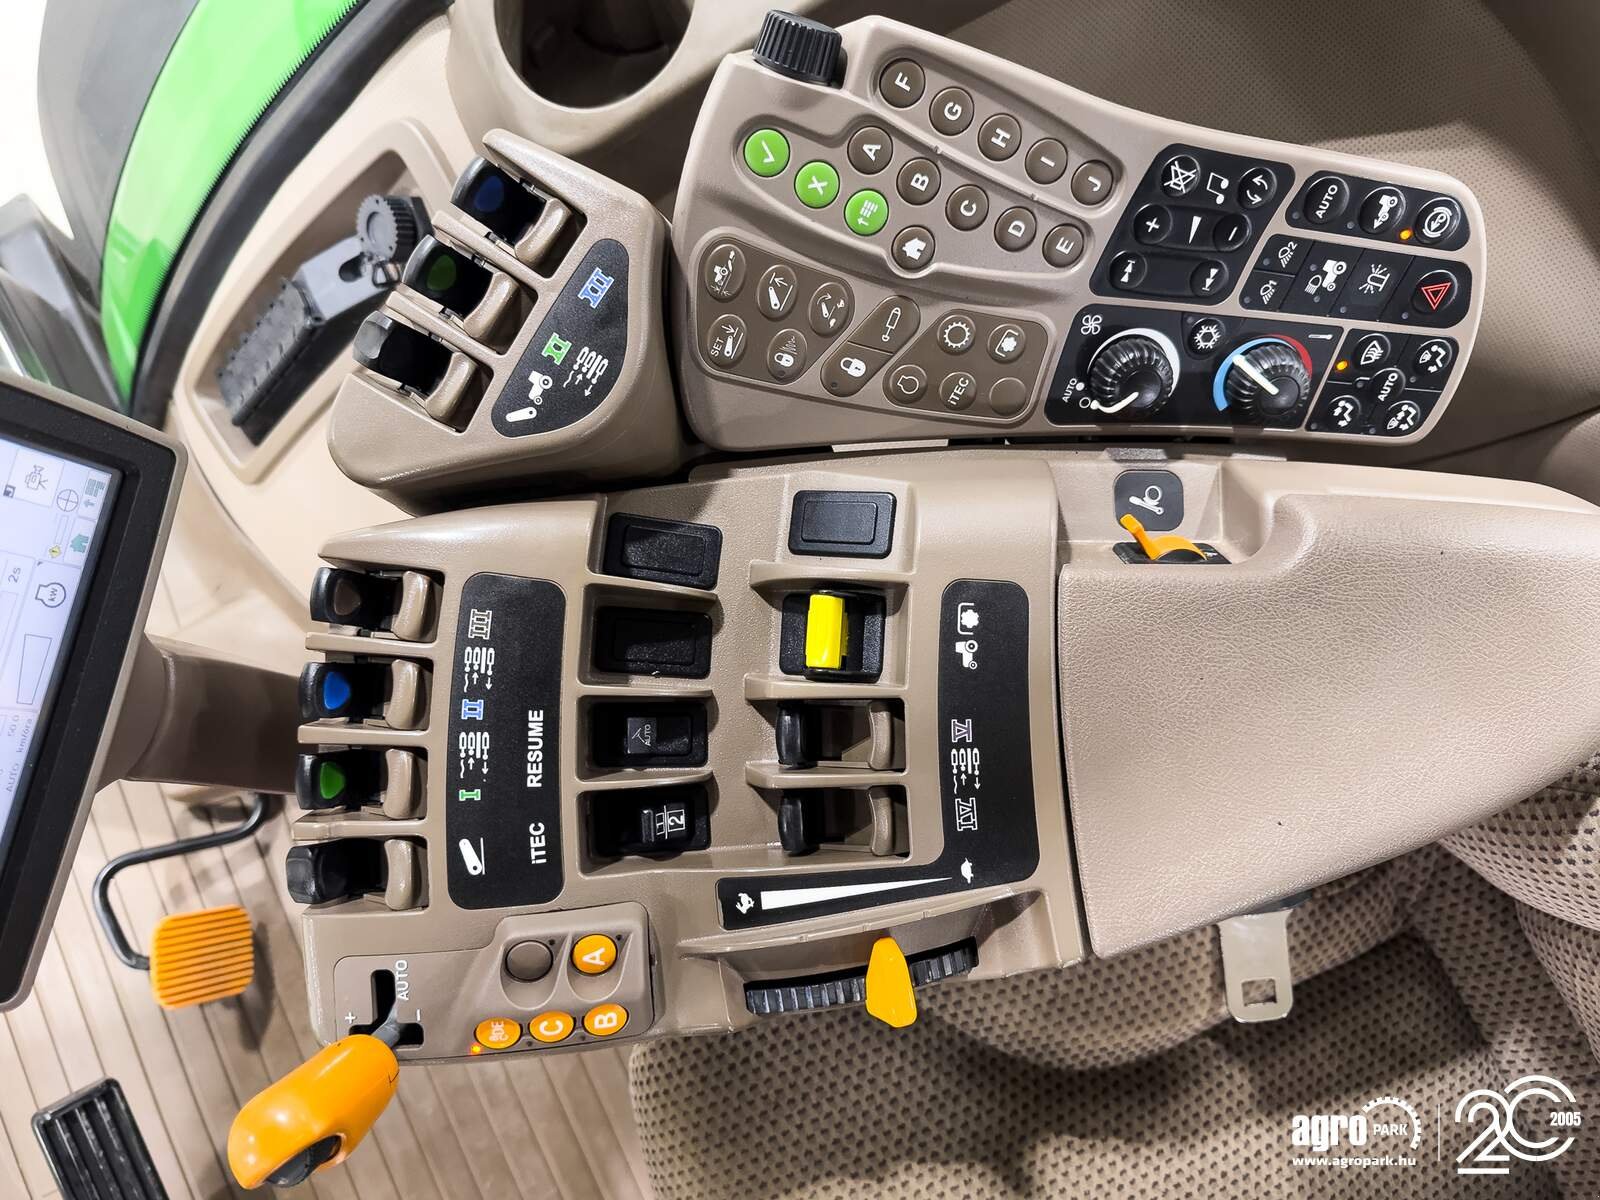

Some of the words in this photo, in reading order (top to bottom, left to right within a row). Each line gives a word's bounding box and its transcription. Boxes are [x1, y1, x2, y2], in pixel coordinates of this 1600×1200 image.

[895, 72, 911, 92] F
[944, 102, 962, 121] G
[991, 127, 1011, 148] H
[862, 143, 882, 161] A
[1041, 156, 1056, 168] I
[910, 172, 930, 191] B
[1088, 176, 1102, 191] J
[960, 200, 977, 217] C
[1315, 184, 1338, 219] AUTO
[1008, 220, 1026, 238] D
[1056, 237, 1075, 255] E
[711, 337, 724, 357] SET
[948, 377, 969, 405] iTEC
[1062, 377, 1077, 403] AUTO
[1379, 371, 1399, 402] AUTO
[644, 724, 652, 746] AUTO
[527, 709, 544, 788] RESUME
[530, 823, 547, 865] iTEC
[583, 947, 606, 966] A
[395, 959, 409, 1001] AUTO
[539, 1020, 564, 1036] C
[594, 1012, 618, 1029] B
